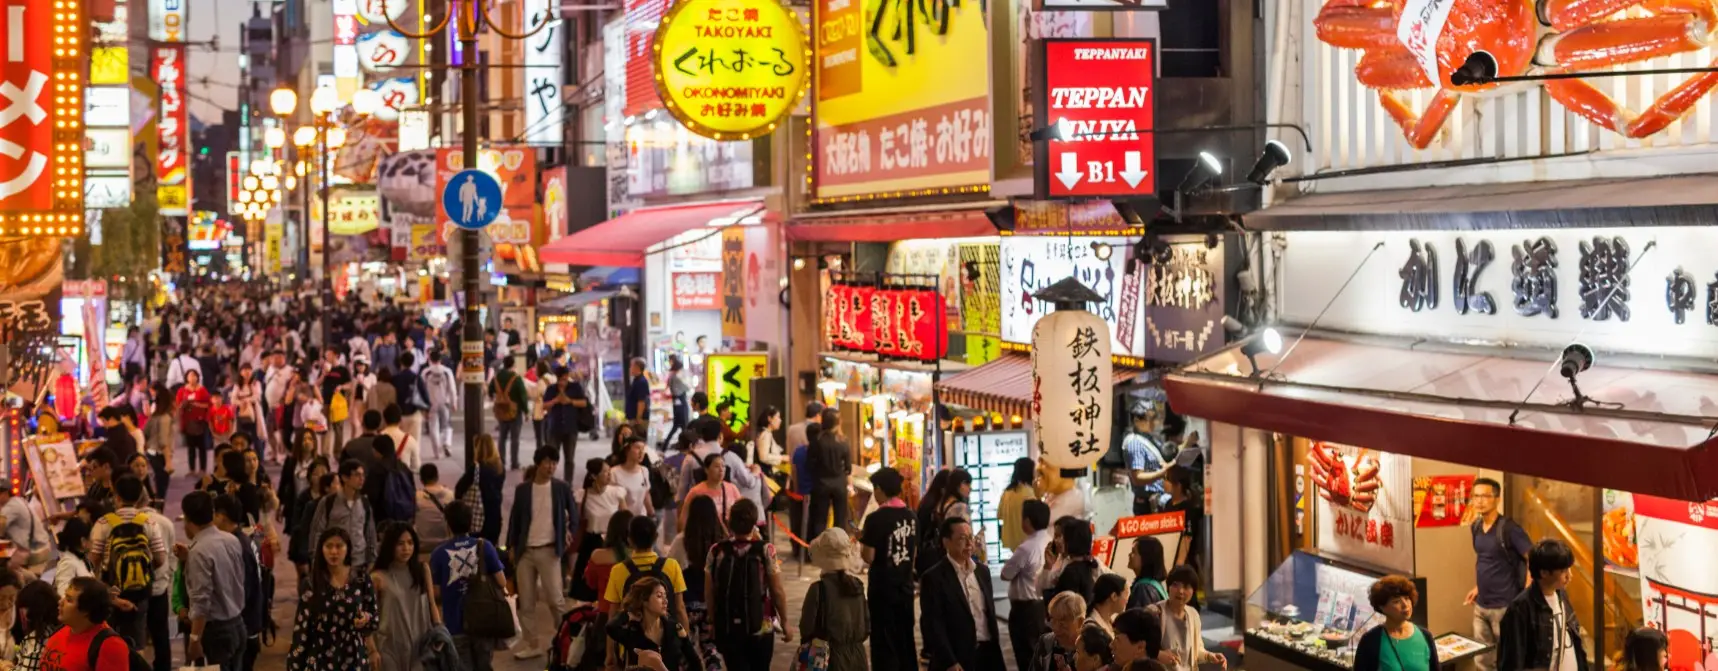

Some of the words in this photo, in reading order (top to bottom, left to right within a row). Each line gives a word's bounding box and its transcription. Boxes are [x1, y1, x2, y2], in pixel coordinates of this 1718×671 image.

[694, 26, 773, 38] TAKOYAKI
[674, 47, 795, 77] くれおーる
[1074, 48, 1148, 60] TEPPANYAKI
[683, 87, 785, 99] OKONOMIYAKI
[1051, 87, 1149, 109] TEPPAN
[1054, 119, 1140, 141] INJYA
[1087, 161, 1116, 183] B1
[1067, 325, 1101, 457] 鉄板神社
[1126, 520, 1139, 533] GO
[1140, 518, 1159, 531] down
[893, 519, 911, 566] 神社
